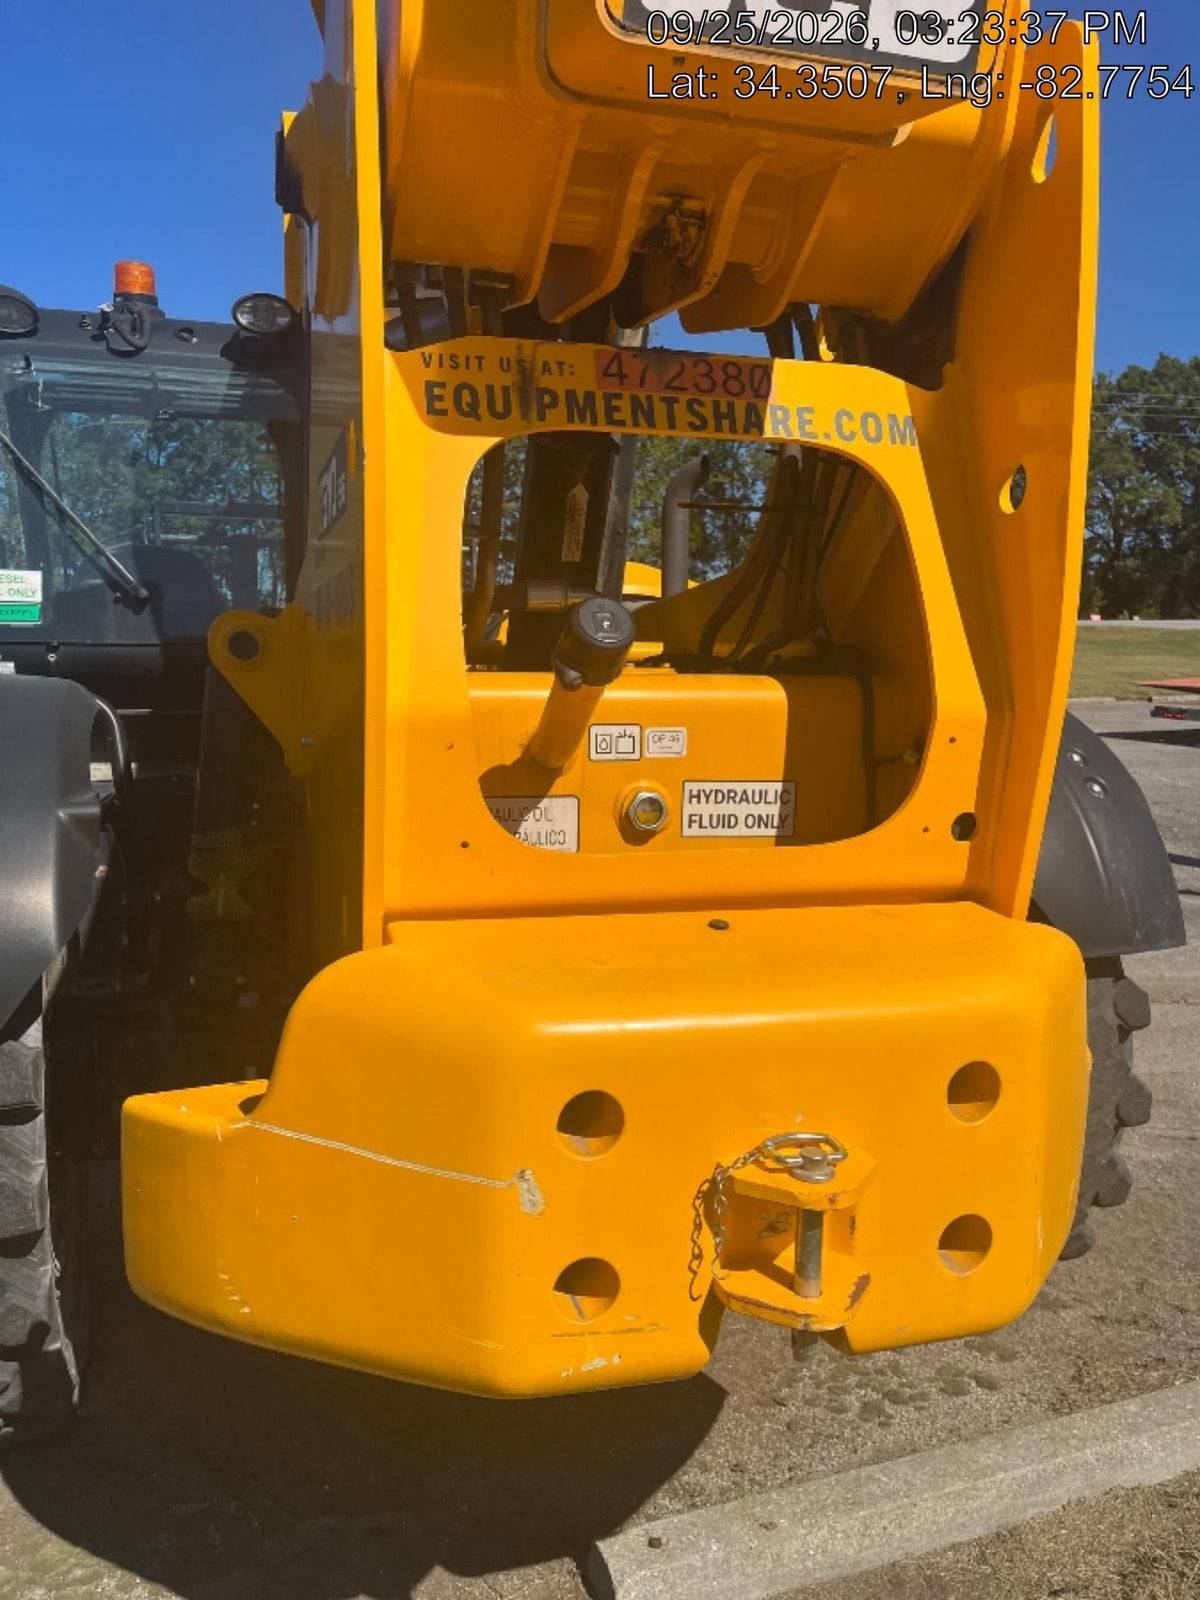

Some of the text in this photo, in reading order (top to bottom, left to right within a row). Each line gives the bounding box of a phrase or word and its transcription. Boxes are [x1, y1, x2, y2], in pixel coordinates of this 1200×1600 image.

[421, 351, 575, 377] VISIT US AT:
[602, 350, 772, 399] 472380
[424, 379, 917, 448] EQUIPMENTSHARE.COM
[687, 788, 791, 805] HYDRAULIC
[687, 813, 789, 830] FLUID ONLY
